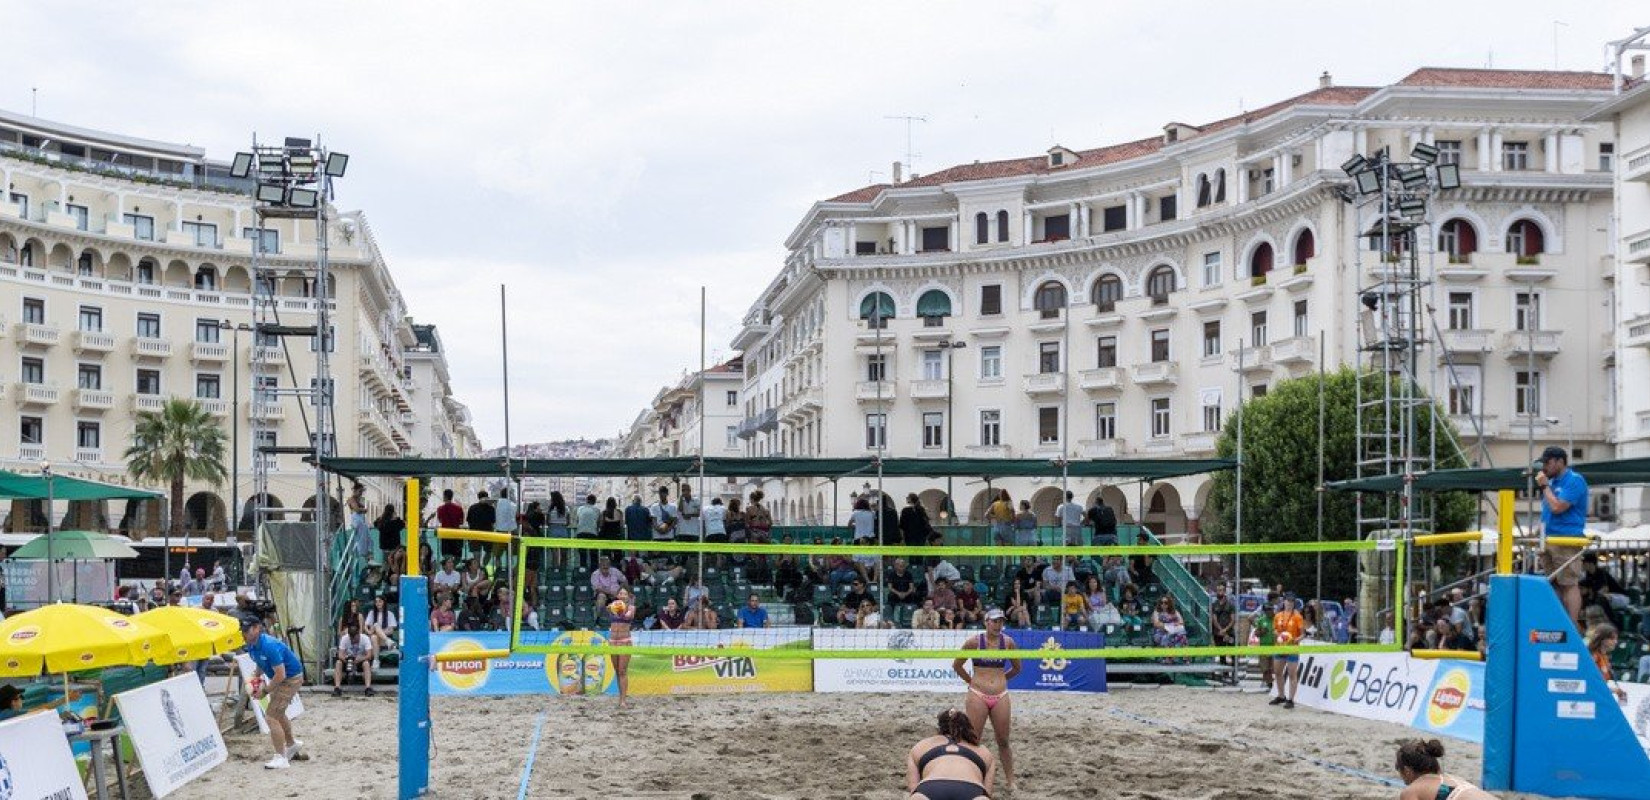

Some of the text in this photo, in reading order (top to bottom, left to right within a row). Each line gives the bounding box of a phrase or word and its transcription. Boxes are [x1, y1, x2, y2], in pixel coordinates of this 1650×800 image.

[714, 656, 755, 678] VITA
[887, 668, 960, 679] ΘΕΣΣΑΛΟΝΙ
[1042, 673, 1064, 682] STAR
[1348, 662, 1419, 712] Befon
